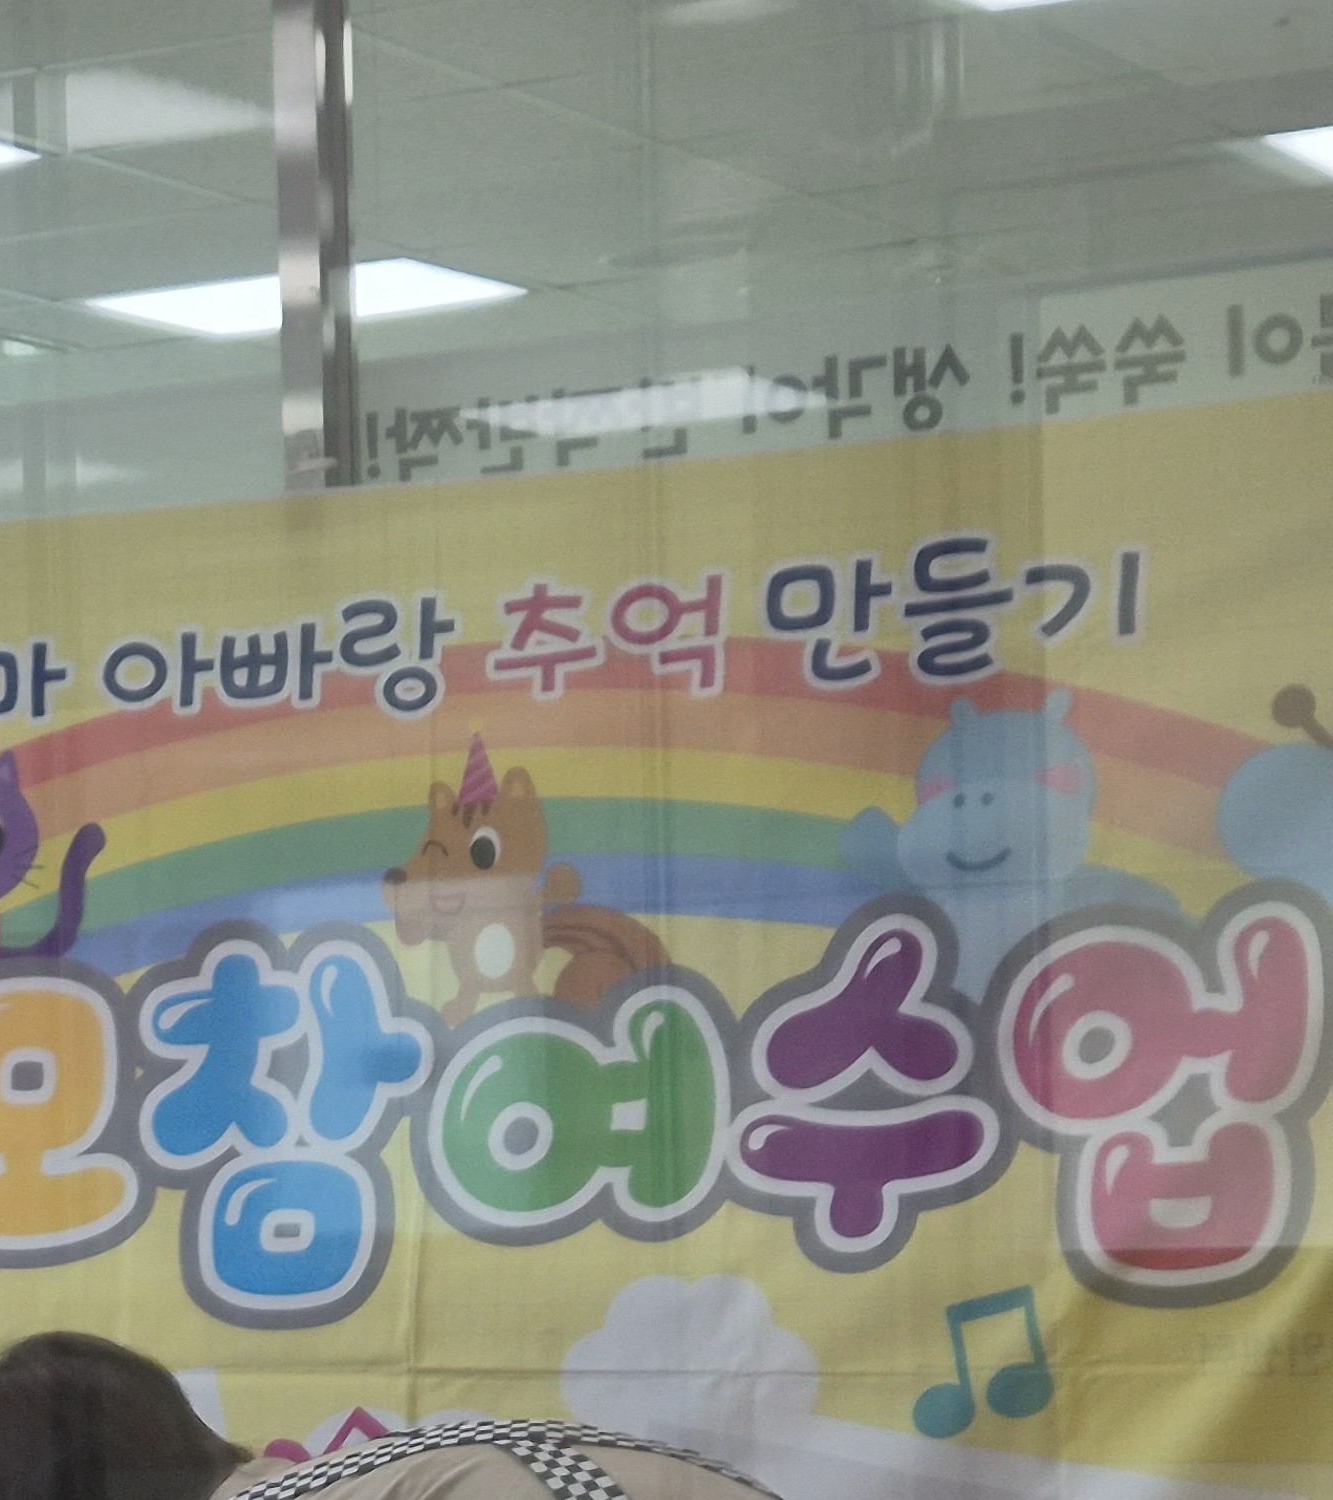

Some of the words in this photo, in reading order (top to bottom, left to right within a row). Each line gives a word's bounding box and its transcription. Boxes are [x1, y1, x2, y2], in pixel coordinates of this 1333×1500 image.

[102, 597, 455, 713] 아빠랑
[493, 573, 724, 694] 추억
[765, 537, 1141, 684] 만들기
